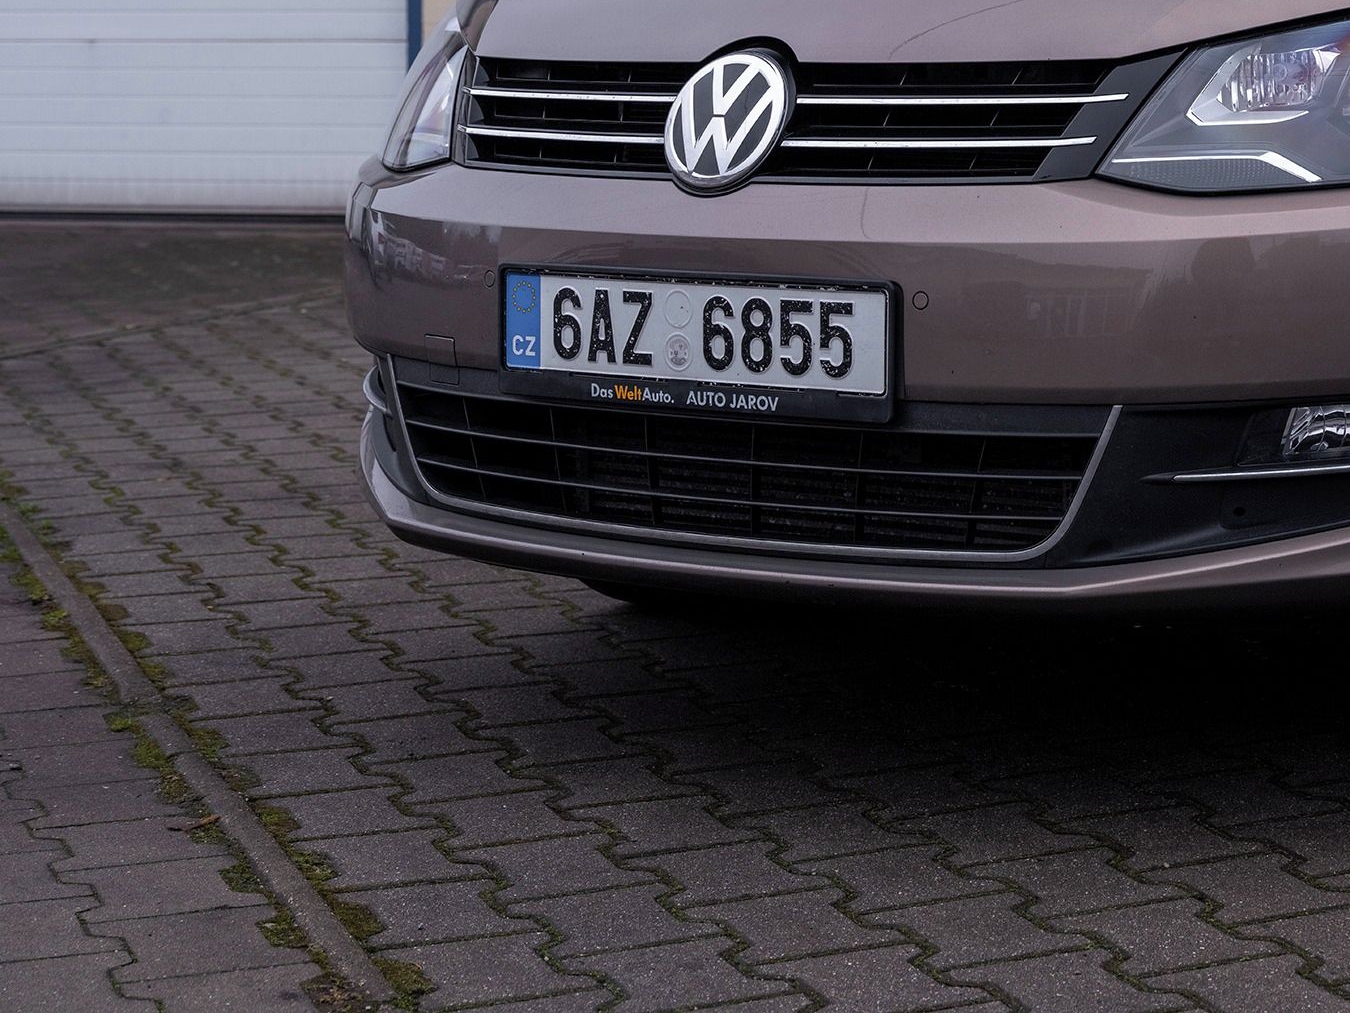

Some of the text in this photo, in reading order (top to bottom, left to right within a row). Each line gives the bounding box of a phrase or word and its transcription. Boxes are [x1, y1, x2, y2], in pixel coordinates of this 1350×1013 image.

[552, 285, 856, 380] 6AZ 6855
[511, 334, 537, 357] CZ
[686, 390, 780, 412] AUTO JAROV
